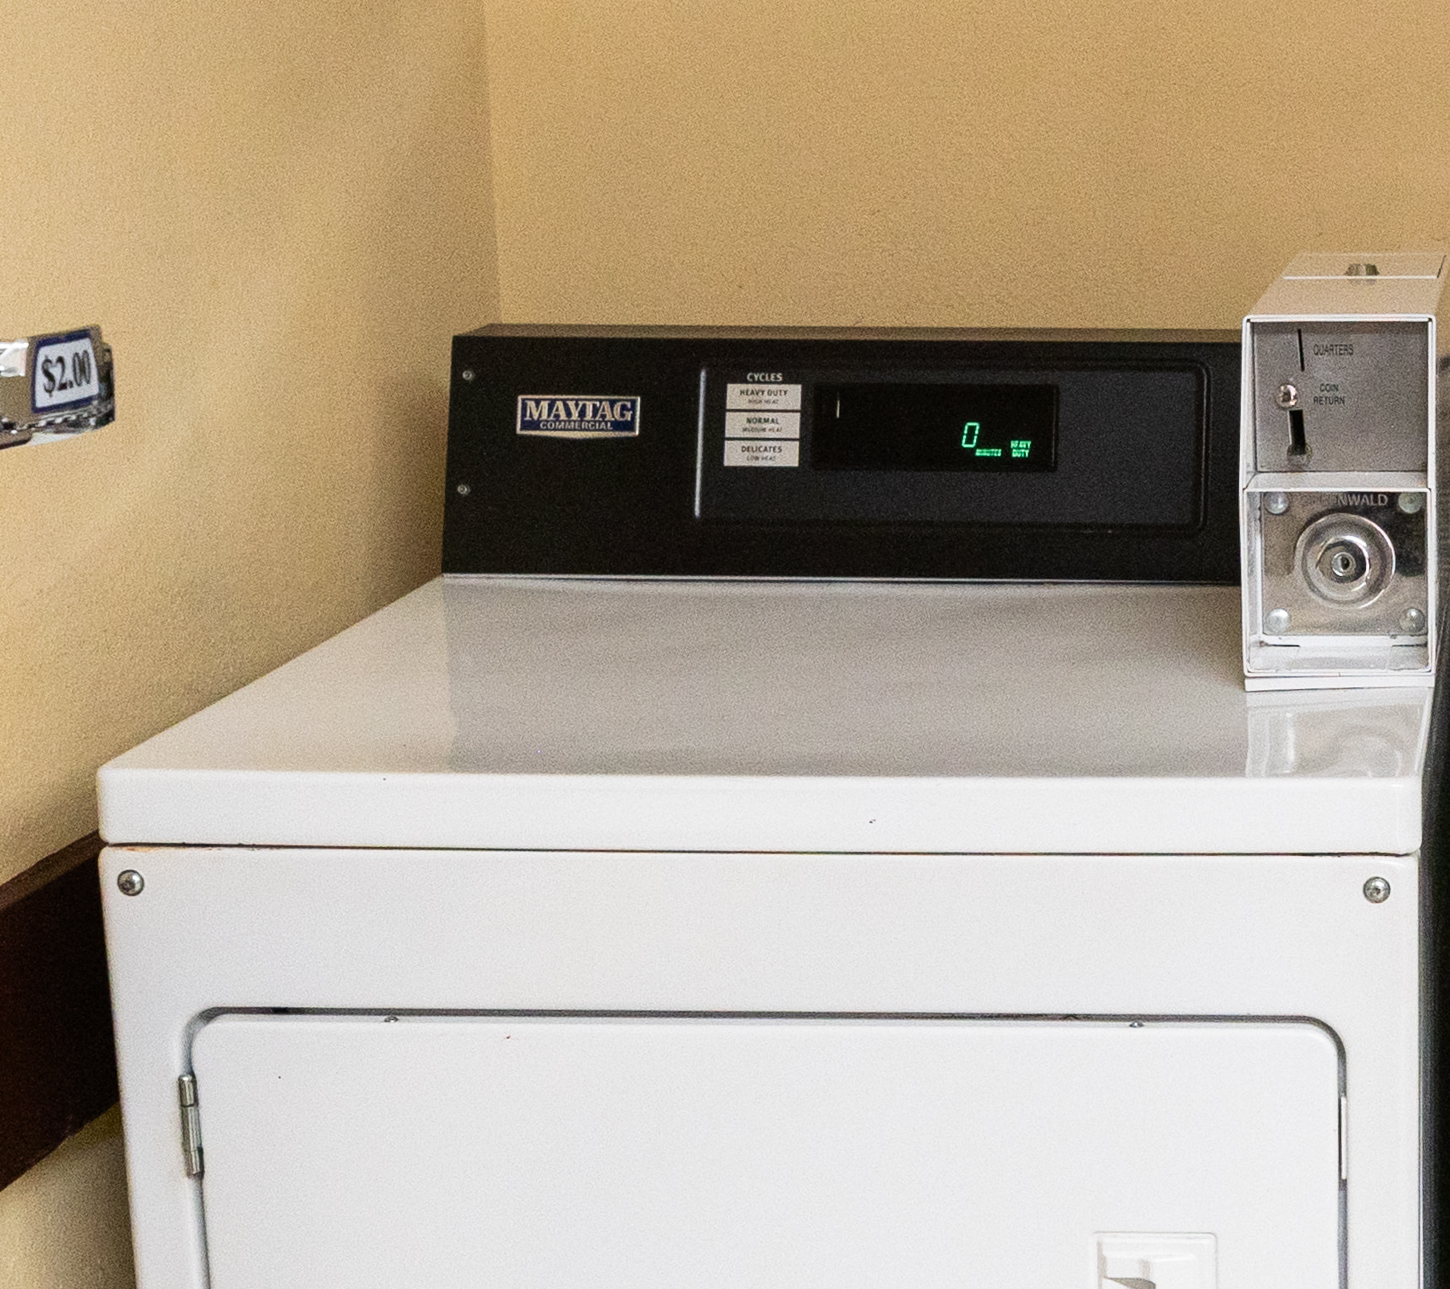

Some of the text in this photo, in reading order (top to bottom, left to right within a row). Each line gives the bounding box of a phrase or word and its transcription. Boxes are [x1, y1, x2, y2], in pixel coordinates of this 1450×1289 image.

[1313, 343, 1354, 356] QUARTERS
[41, 349, 92, 397] $2.00
[746, 372, 783, 382] CYCLES
[1313, 396, 1346, 406] RETURN
[524, 400, 633, 421] MAYTAG
[540, 421, 613, 430] COMMERCIAL
[961, 422, 980, 448] 0
[741, 445, 782, 453] DELICATES
